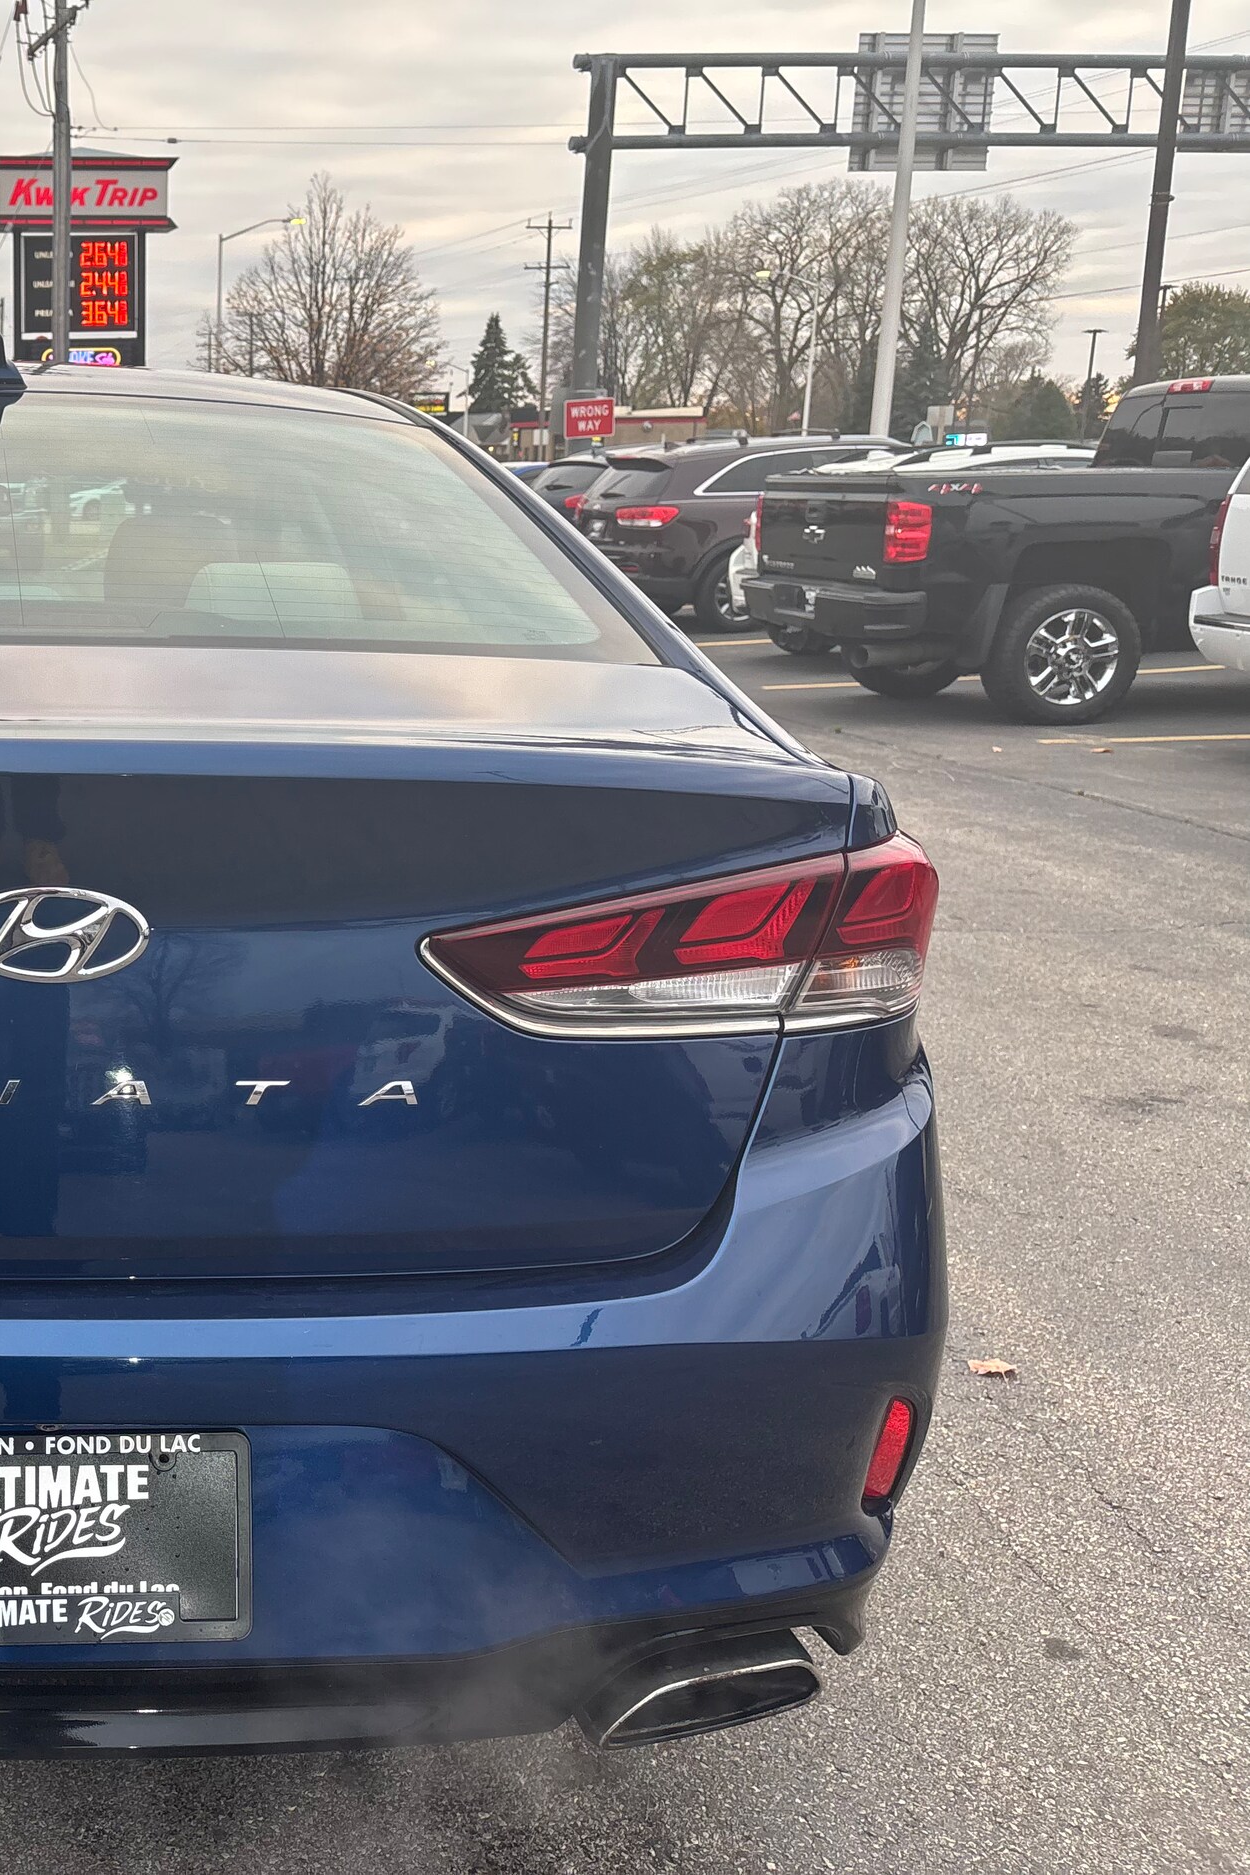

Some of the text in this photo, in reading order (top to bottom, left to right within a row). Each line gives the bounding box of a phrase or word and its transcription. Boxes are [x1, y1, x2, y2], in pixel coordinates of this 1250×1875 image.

[8, 177, 158, 207] KWK TRIP
[570, 404, 610, 418] WRONG
[577, 418, 602, 432] WAY
[45, 1436, 112, 1455] FOND
[120, 1435, 151, 1453] DU
[160, 1434, 201, 1453] LAC
